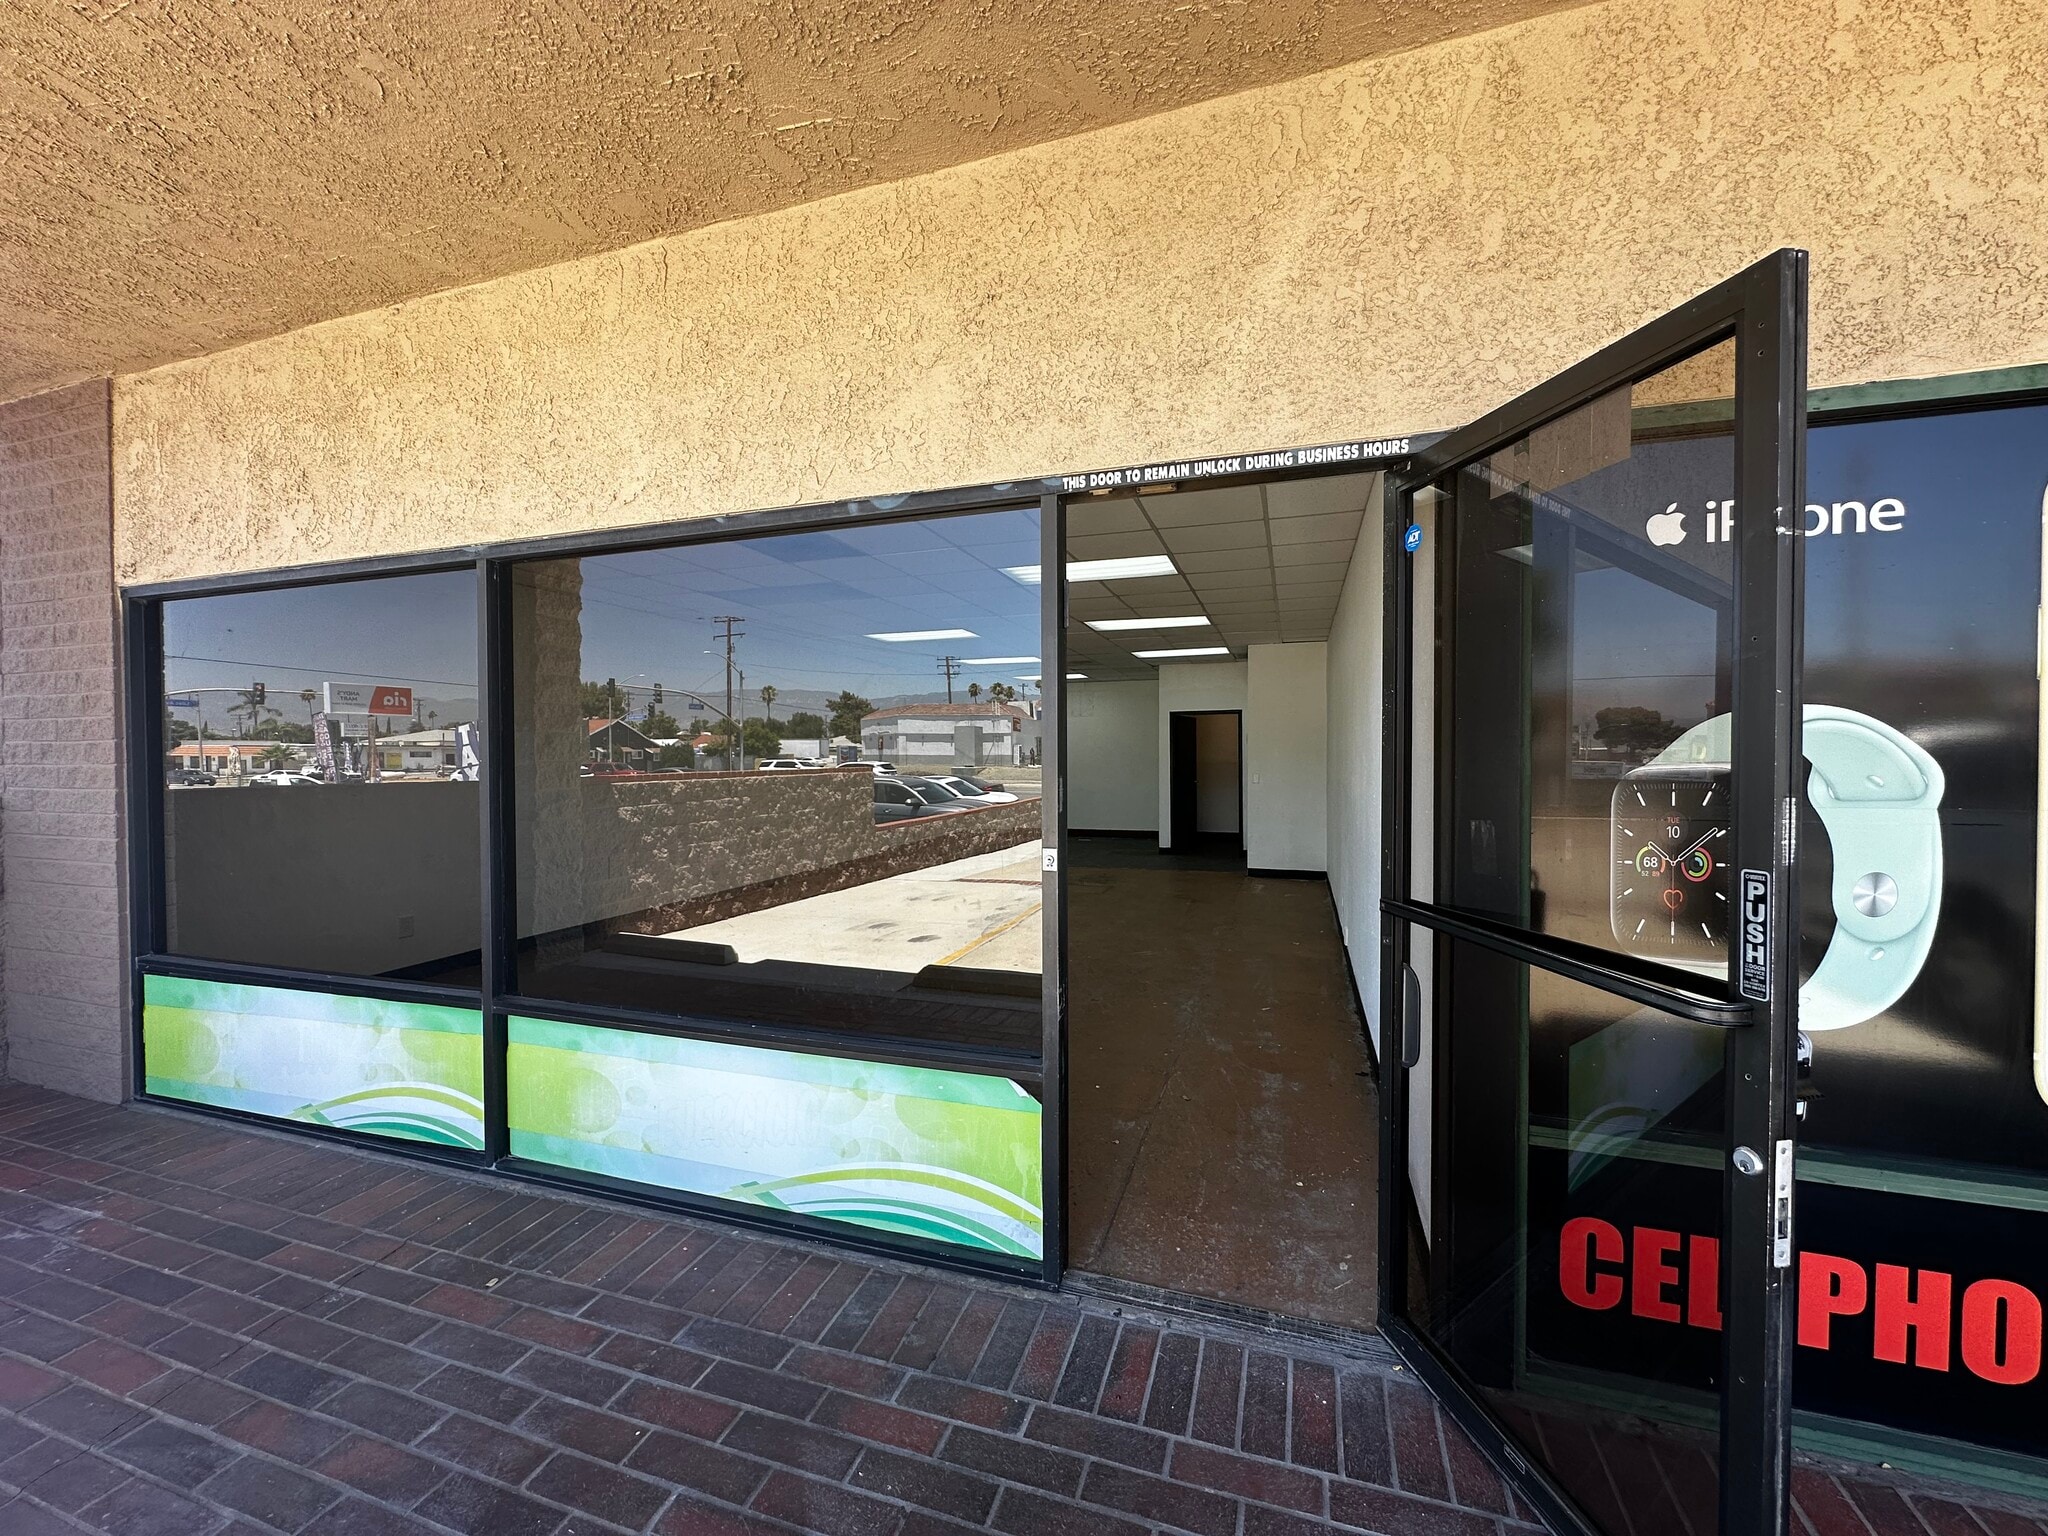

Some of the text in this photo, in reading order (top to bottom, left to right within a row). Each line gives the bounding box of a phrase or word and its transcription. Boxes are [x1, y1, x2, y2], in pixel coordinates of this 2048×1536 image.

[1062, 439, 1409, 492] THIS DOOR TO REMAIN UNLOCK DURING BUSINESS HOURS
[1705, 498, 1906, 543] iPone
[1407, 530, 1421, 544] ADT
[1667, 816, 1680, 824] TUE
[1666, 826, 1680, 839] 10
[1643, 856, 1658, 868] 68
[1745, 881, 1766, 965] PUSH
[1749, 964, 1766, 972] DOOR
[1559, 1217, 1722, 1330] CEL
